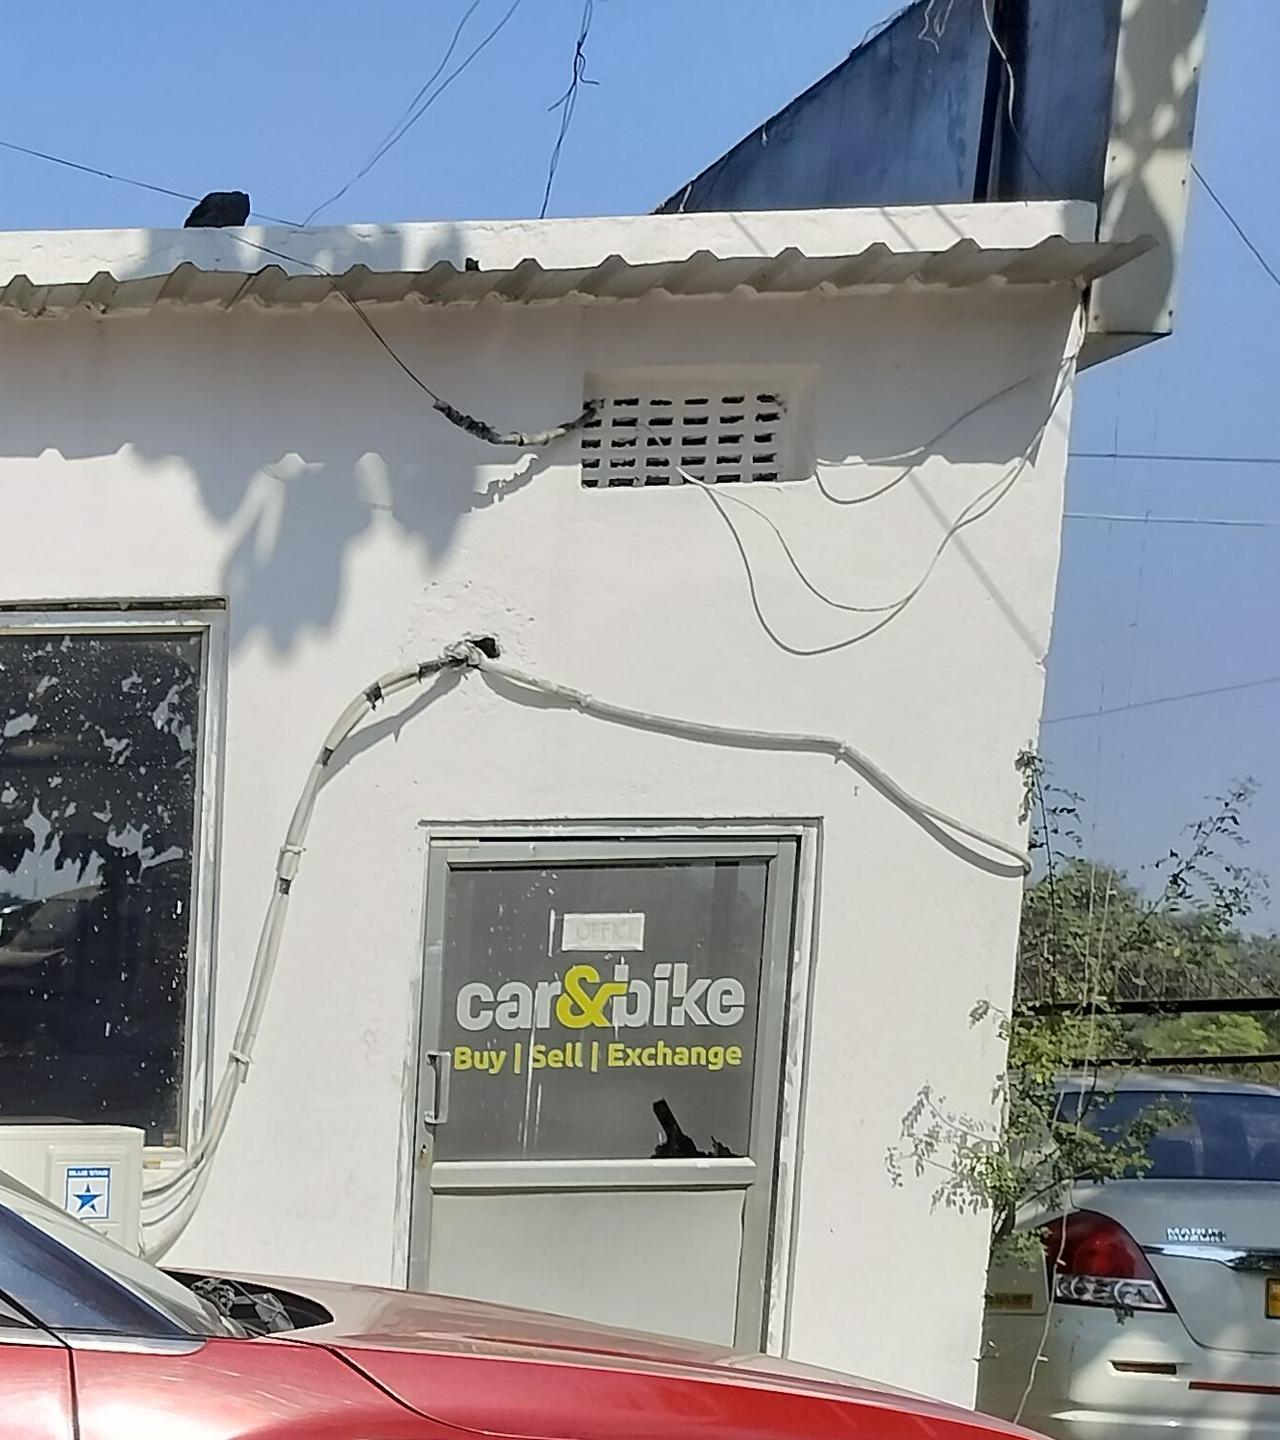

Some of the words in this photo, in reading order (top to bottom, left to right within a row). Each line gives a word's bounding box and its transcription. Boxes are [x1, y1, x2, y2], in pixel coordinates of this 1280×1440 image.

[455, 962, 745, 1031] car&bike
[453, 1045, 507, 1074] Buy
[532, 1041, 583, 1069] Sell
[607, 1040, 743, 1071] Exchange
